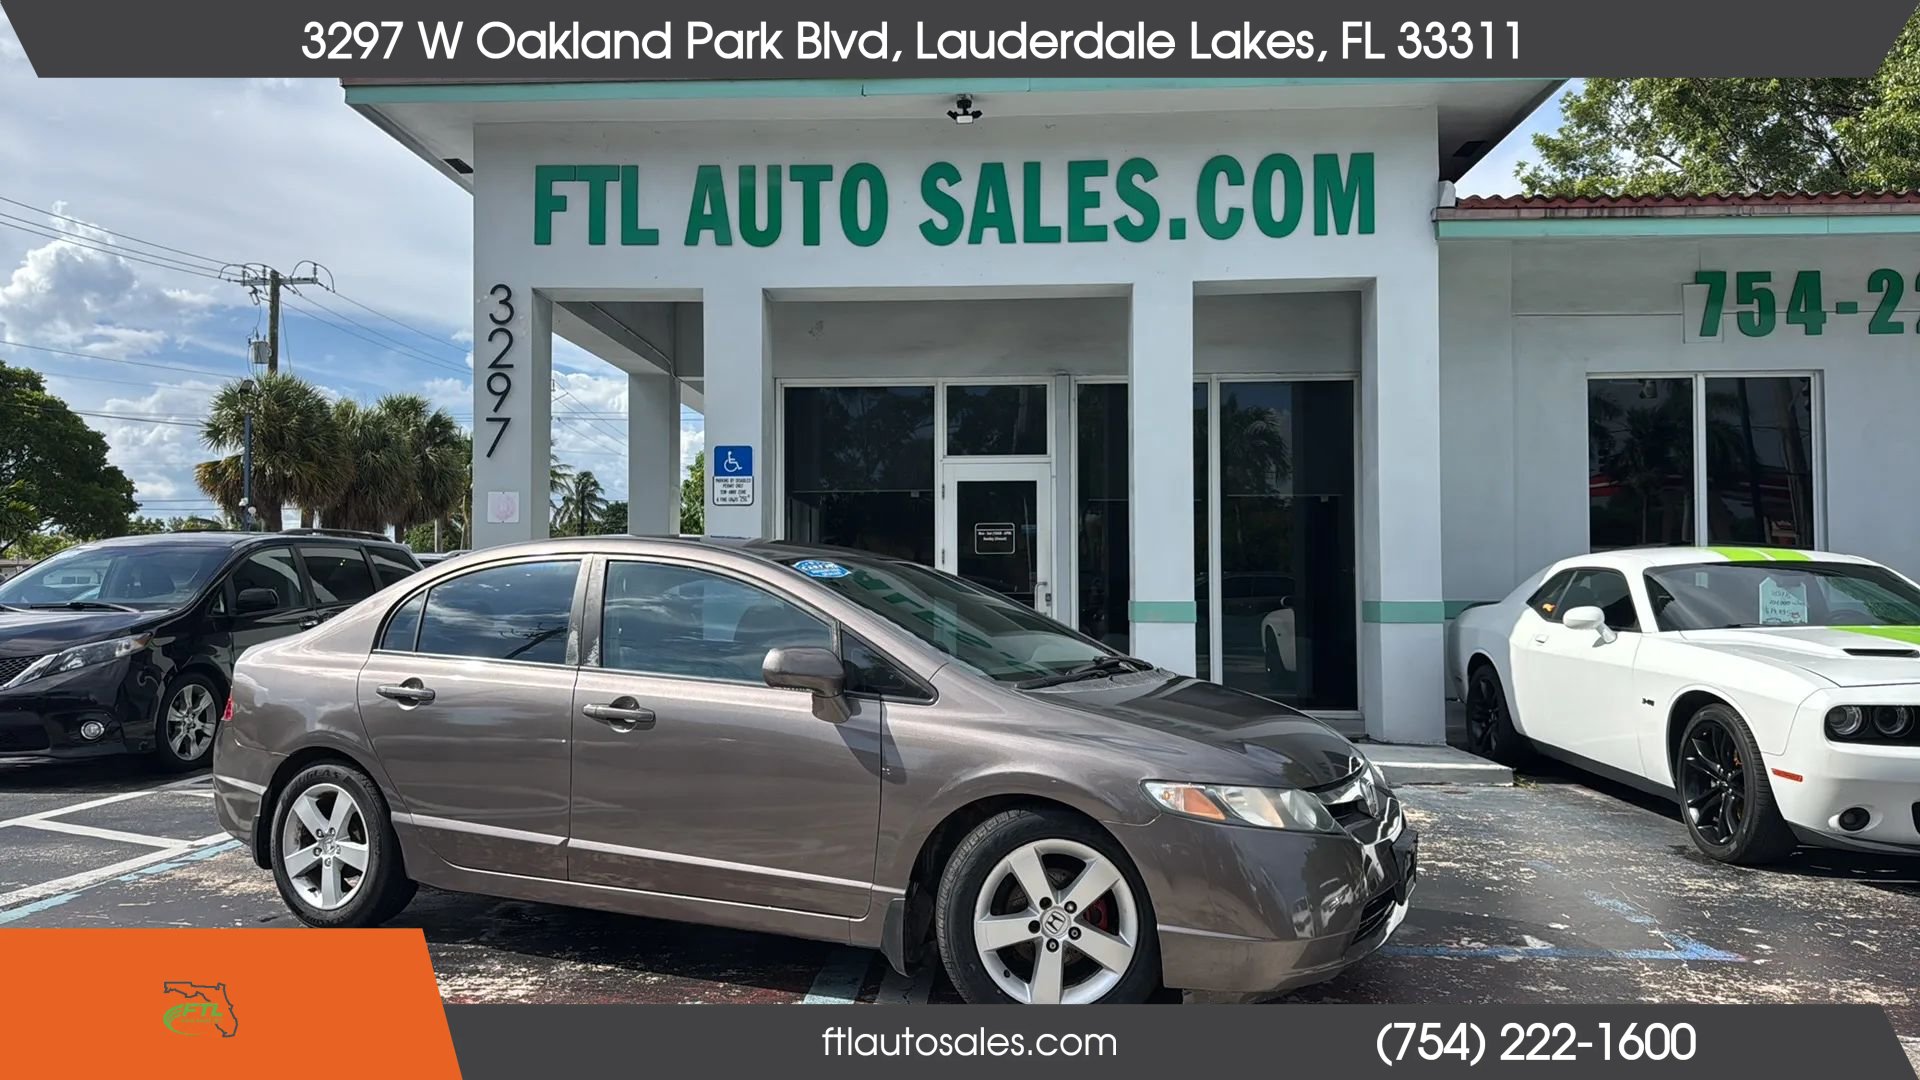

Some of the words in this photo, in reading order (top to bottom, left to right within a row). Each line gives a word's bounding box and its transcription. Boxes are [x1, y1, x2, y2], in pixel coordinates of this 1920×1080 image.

[534, 164, 659, 246] FTL
[684, 163, 889, 247] AUTO
[919, 152, 1376, 246] SALES.COM
[1695, 268, 1920, 337] 754-2
[485, 283, 515, 458] 3297
